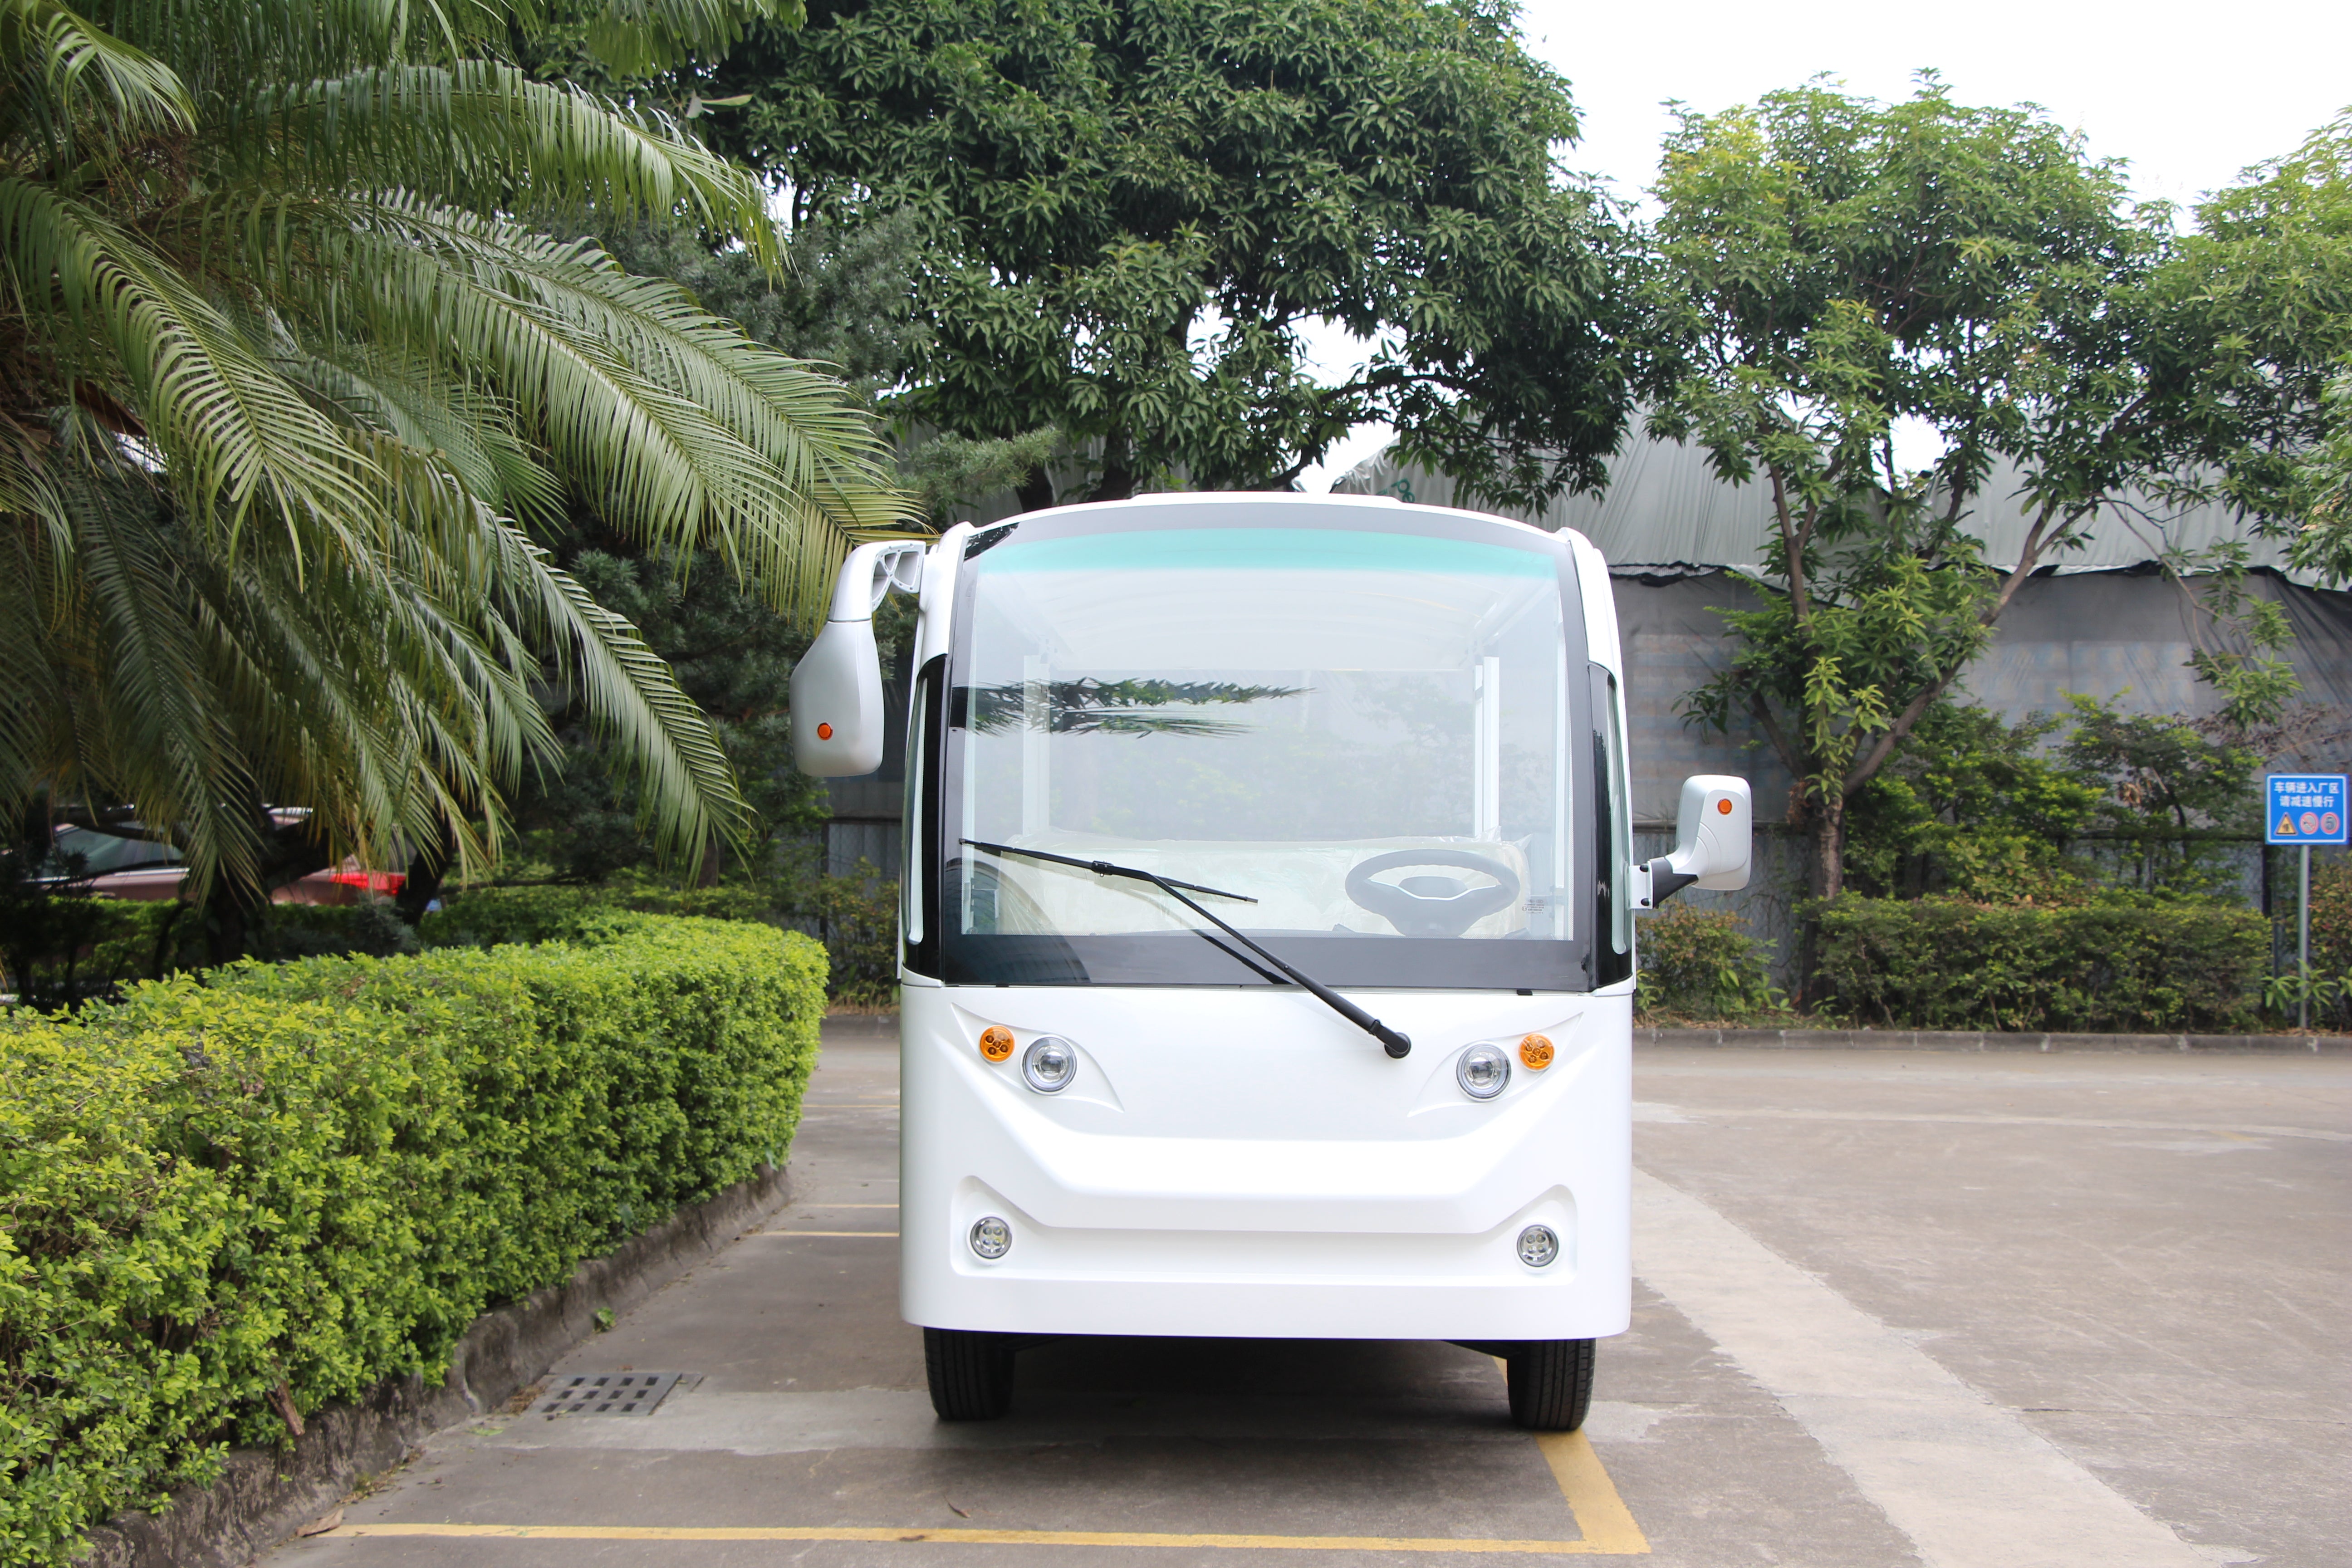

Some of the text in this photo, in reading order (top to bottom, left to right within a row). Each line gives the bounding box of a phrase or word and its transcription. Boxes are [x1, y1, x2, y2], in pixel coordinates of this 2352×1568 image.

[2274, 782, 2339, 794] 车辆进入厂区
[2279, 795, 2334, 807] 请减速慢行
[2326, 817, 2334, 830] 5
